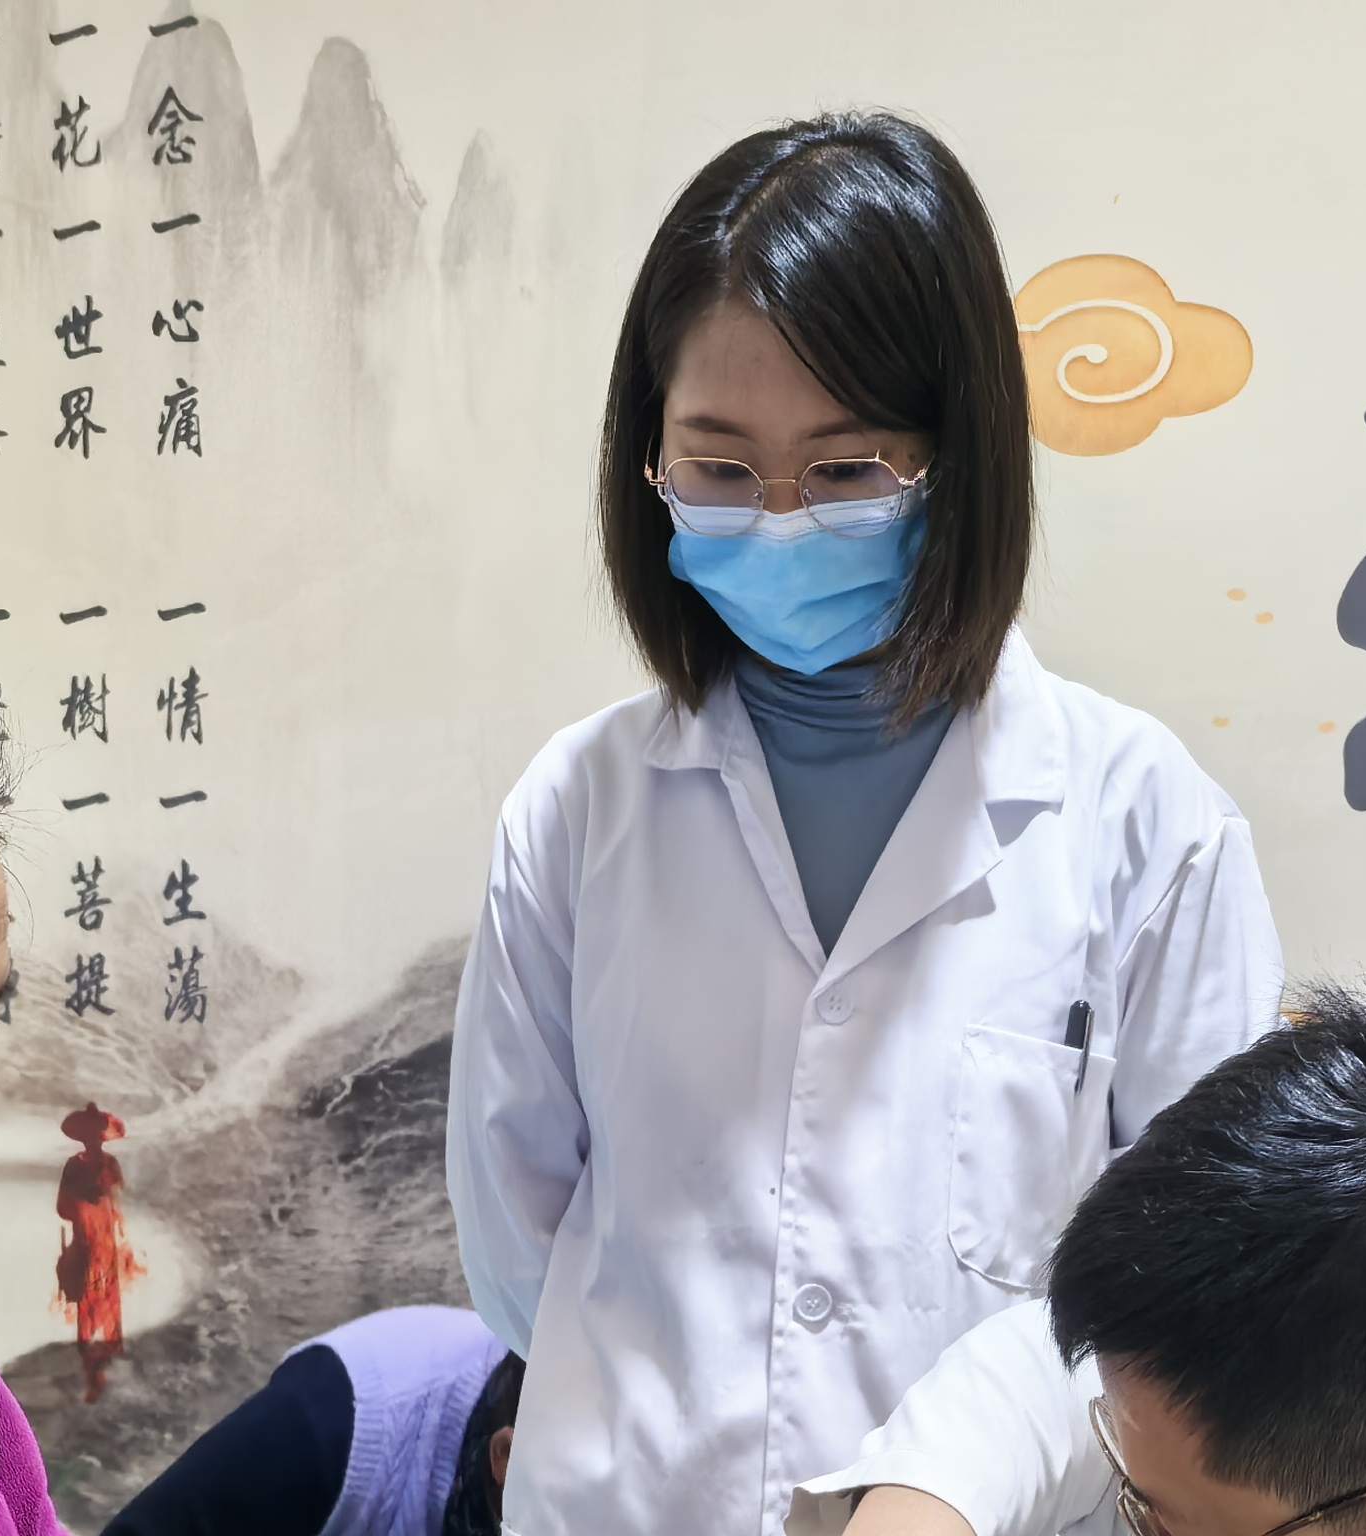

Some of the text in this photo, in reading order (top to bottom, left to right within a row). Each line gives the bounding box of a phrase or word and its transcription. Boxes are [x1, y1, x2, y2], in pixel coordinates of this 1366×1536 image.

[48, 23, 108, 460] 一花一世界
[147, 14, 205, 458] 一念一心痛
